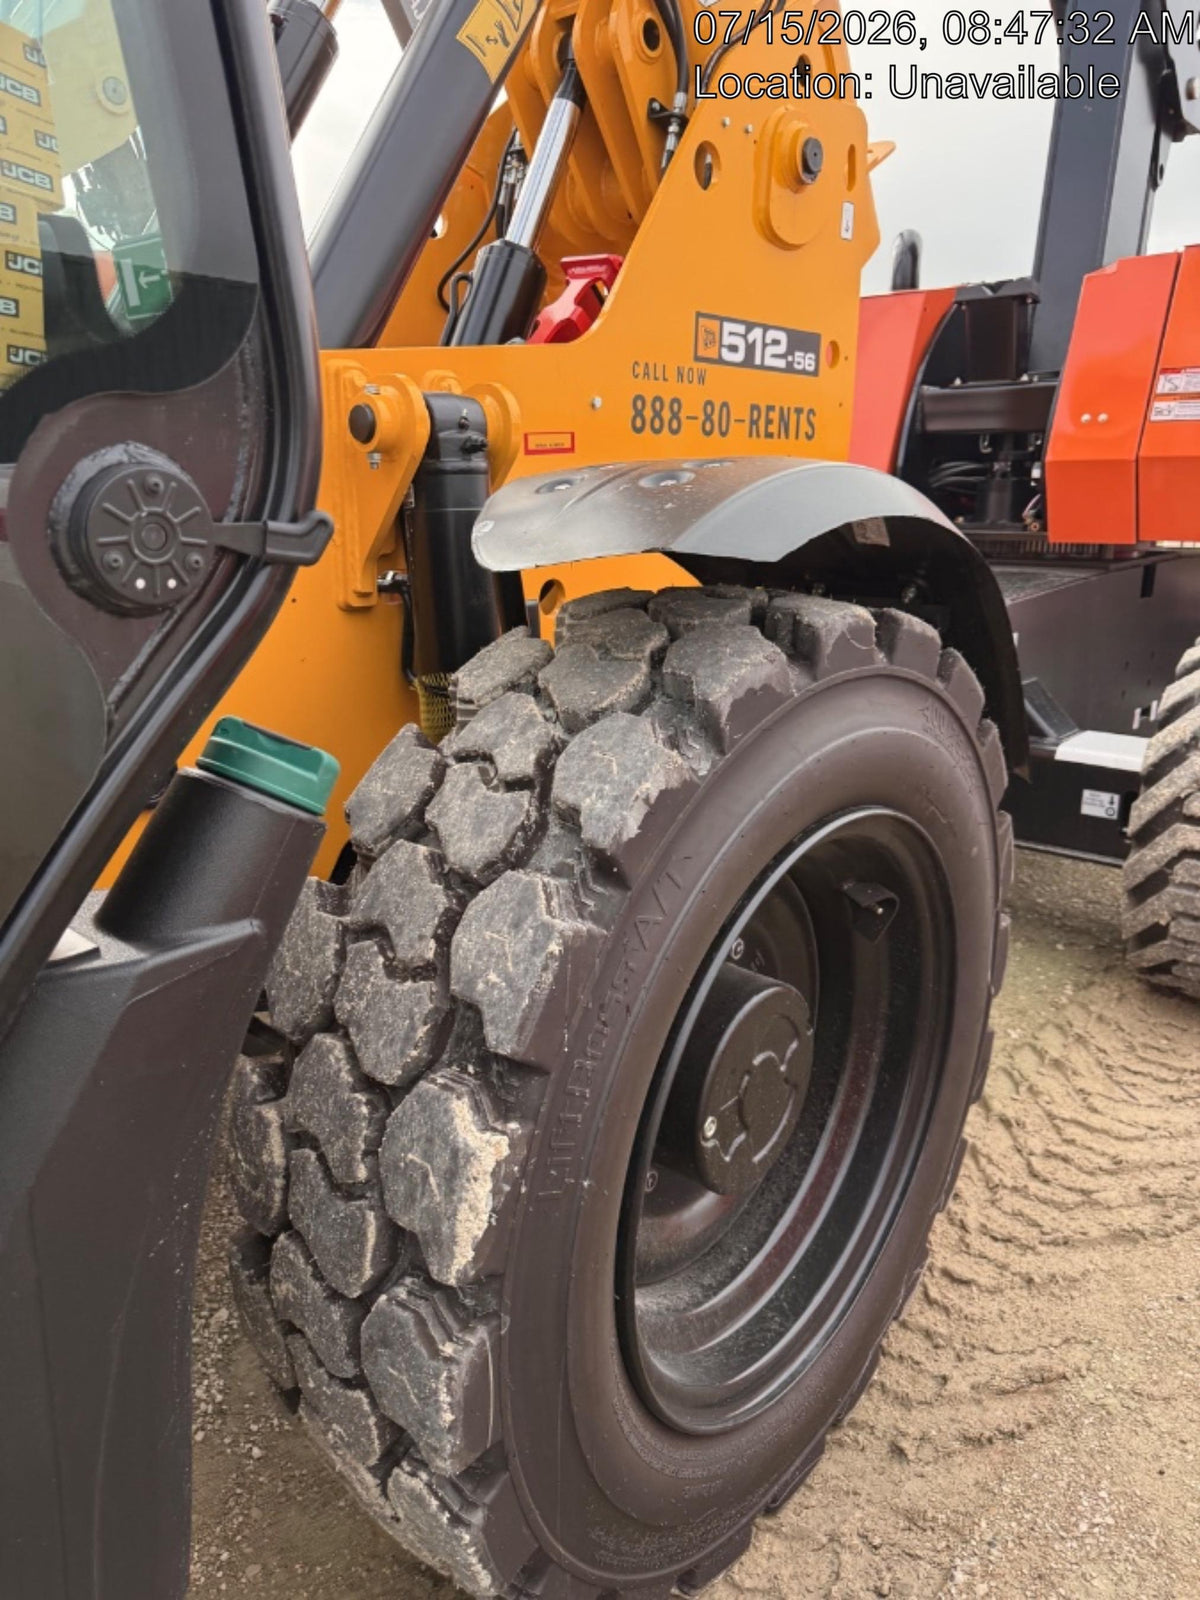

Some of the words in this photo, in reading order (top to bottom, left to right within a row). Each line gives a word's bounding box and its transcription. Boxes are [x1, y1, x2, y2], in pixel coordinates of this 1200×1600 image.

[3, 161, 52, 189] JCB
[8, 254, 43, 276] JC
[632, 361, 669, 382] CALL
[677, 366, 707, 385] NOW
[631, 394, 816, 441] 888-80-RENTS
